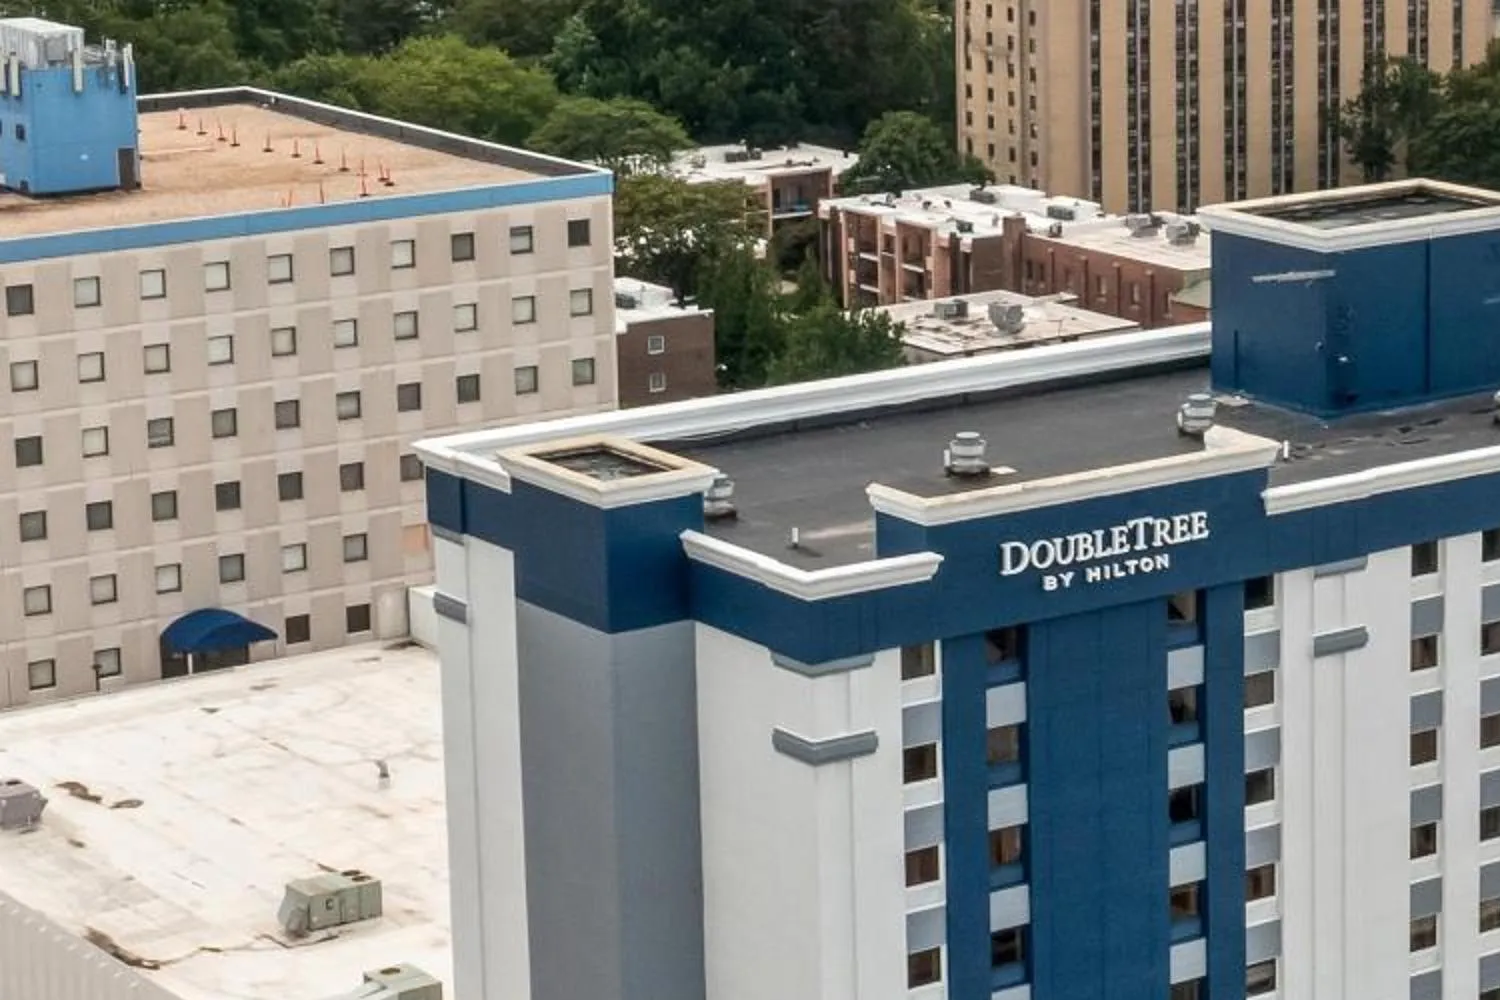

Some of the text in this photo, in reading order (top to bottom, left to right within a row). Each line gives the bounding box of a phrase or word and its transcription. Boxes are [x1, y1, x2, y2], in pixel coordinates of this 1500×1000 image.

[1000, 511, 1210, 577] DOUBLETREE
[1042, 553, 1170, 592] BY HILTON
